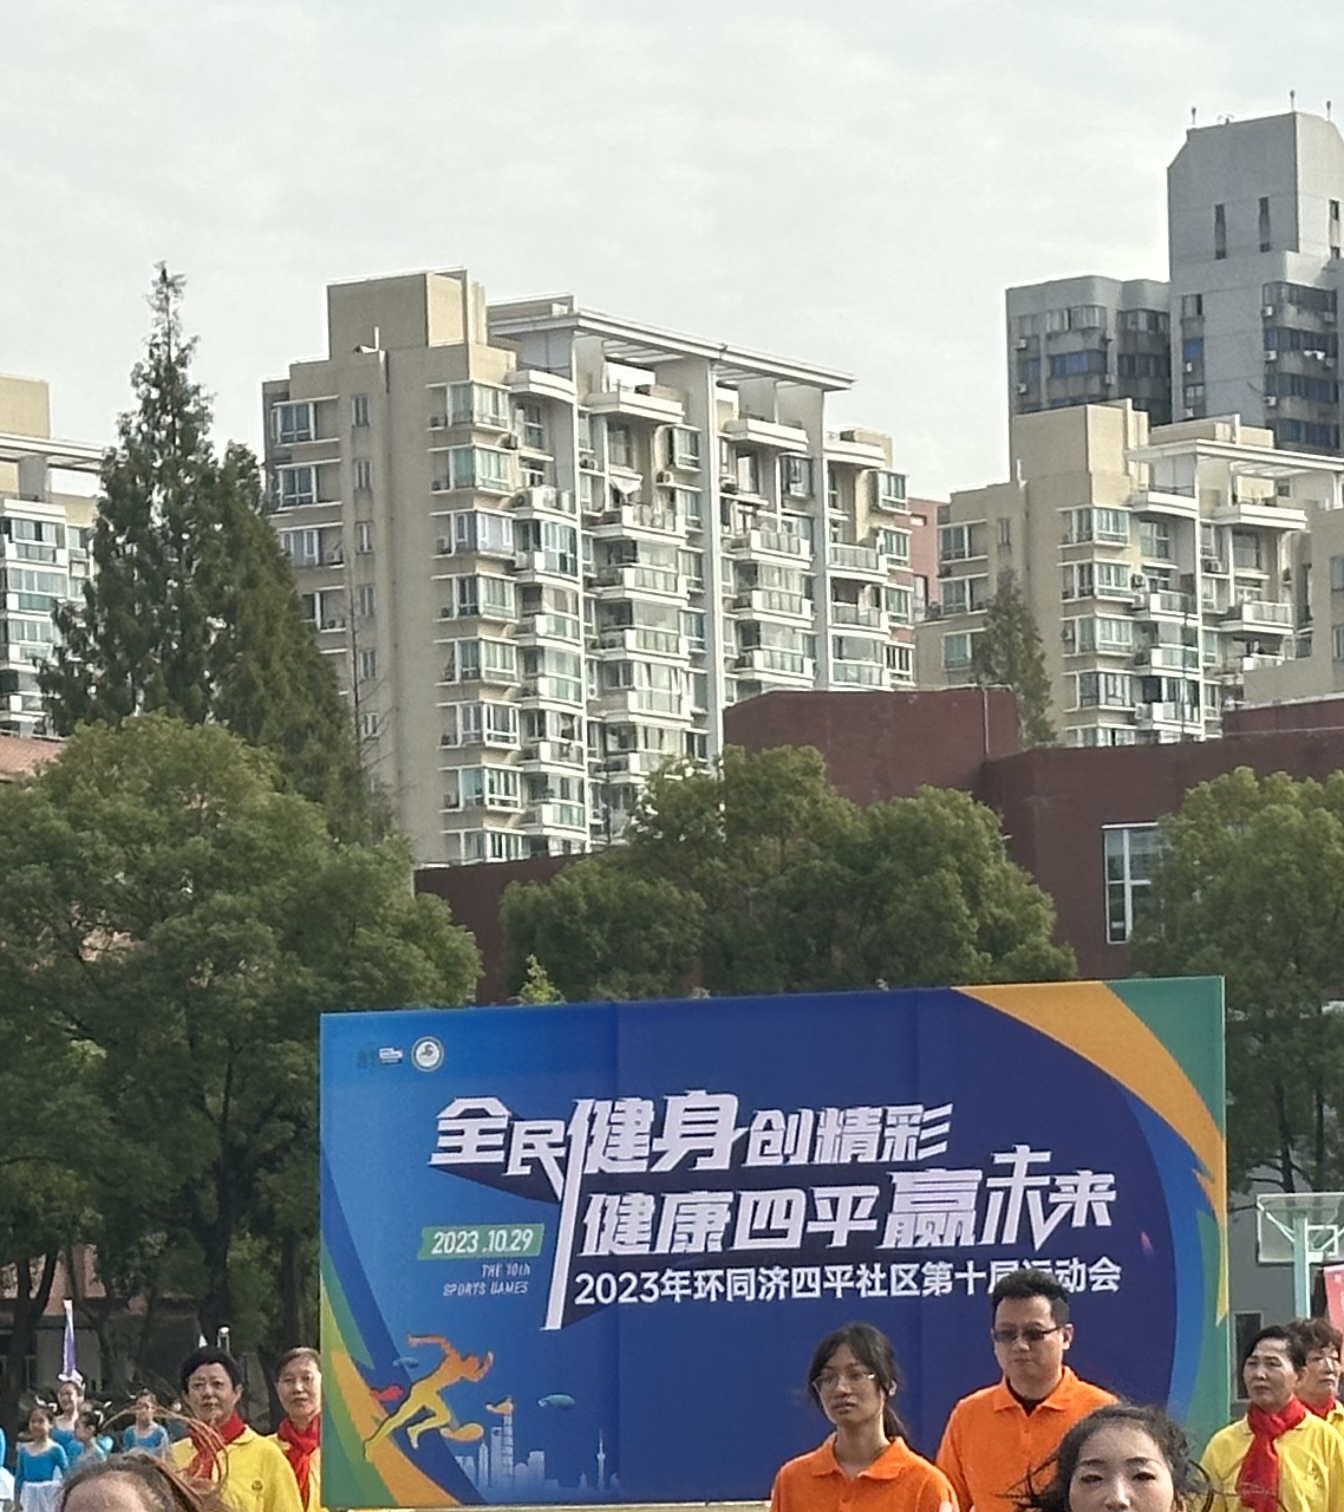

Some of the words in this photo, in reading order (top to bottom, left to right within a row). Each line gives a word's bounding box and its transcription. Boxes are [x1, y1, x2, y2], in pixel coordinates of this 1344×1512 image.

[576, 1144, 1117, 1257] 健康四平赢未来
[574, 1255, 1122, 1305] 2023年环同济四平社区第十动会
